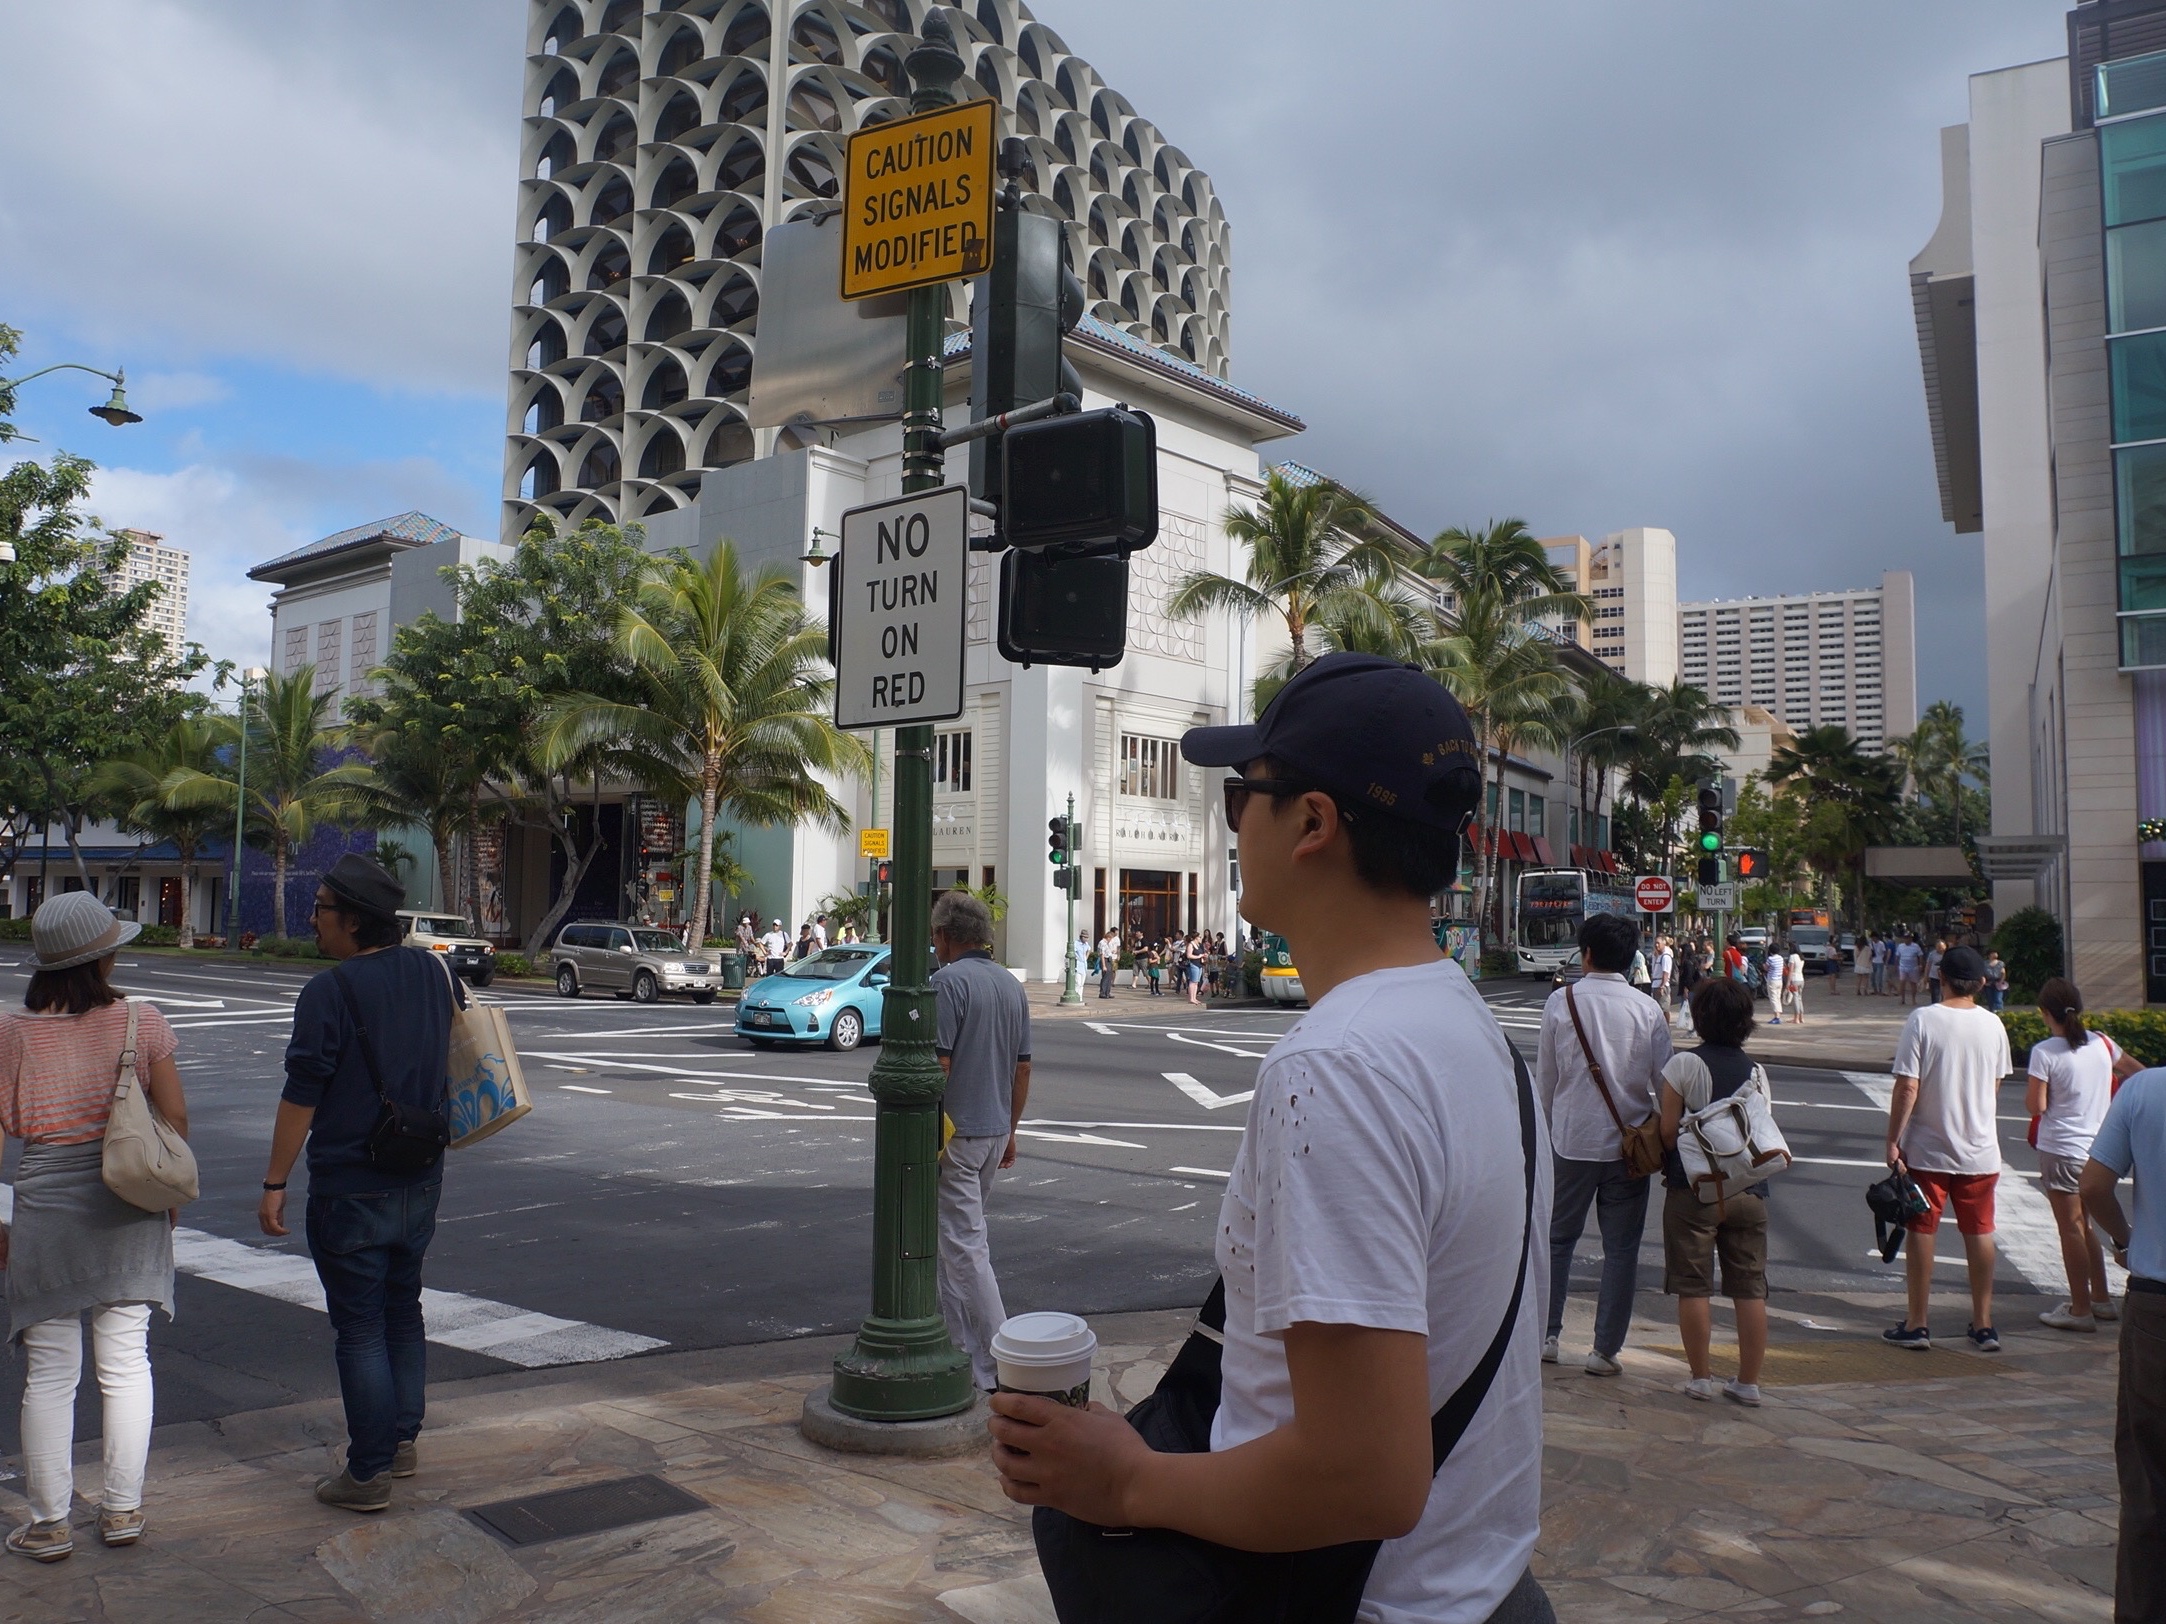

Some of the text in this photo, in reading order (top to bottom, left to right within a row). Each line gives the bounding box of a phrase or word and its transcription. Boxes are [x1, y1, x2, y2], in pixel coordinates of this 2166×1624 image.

[866, 126, 973, 179] CAUTION
[863, 174, 971, 226] SIGNALS
[855, 221, 977, 275] MODIFIED
[877, 512, 929, 564] NO
[866, 570, 938, 612] TURN
[881, 622, 918, 659] ON
[872, 671, 925, 708] RED
[1366, 782, 1398, 806] 1995
[933, 826, 972, 836] LAUREN
[1700, 885, 1732, 896] NO LEFT
[1707, 898, 1726, 906] TURN
